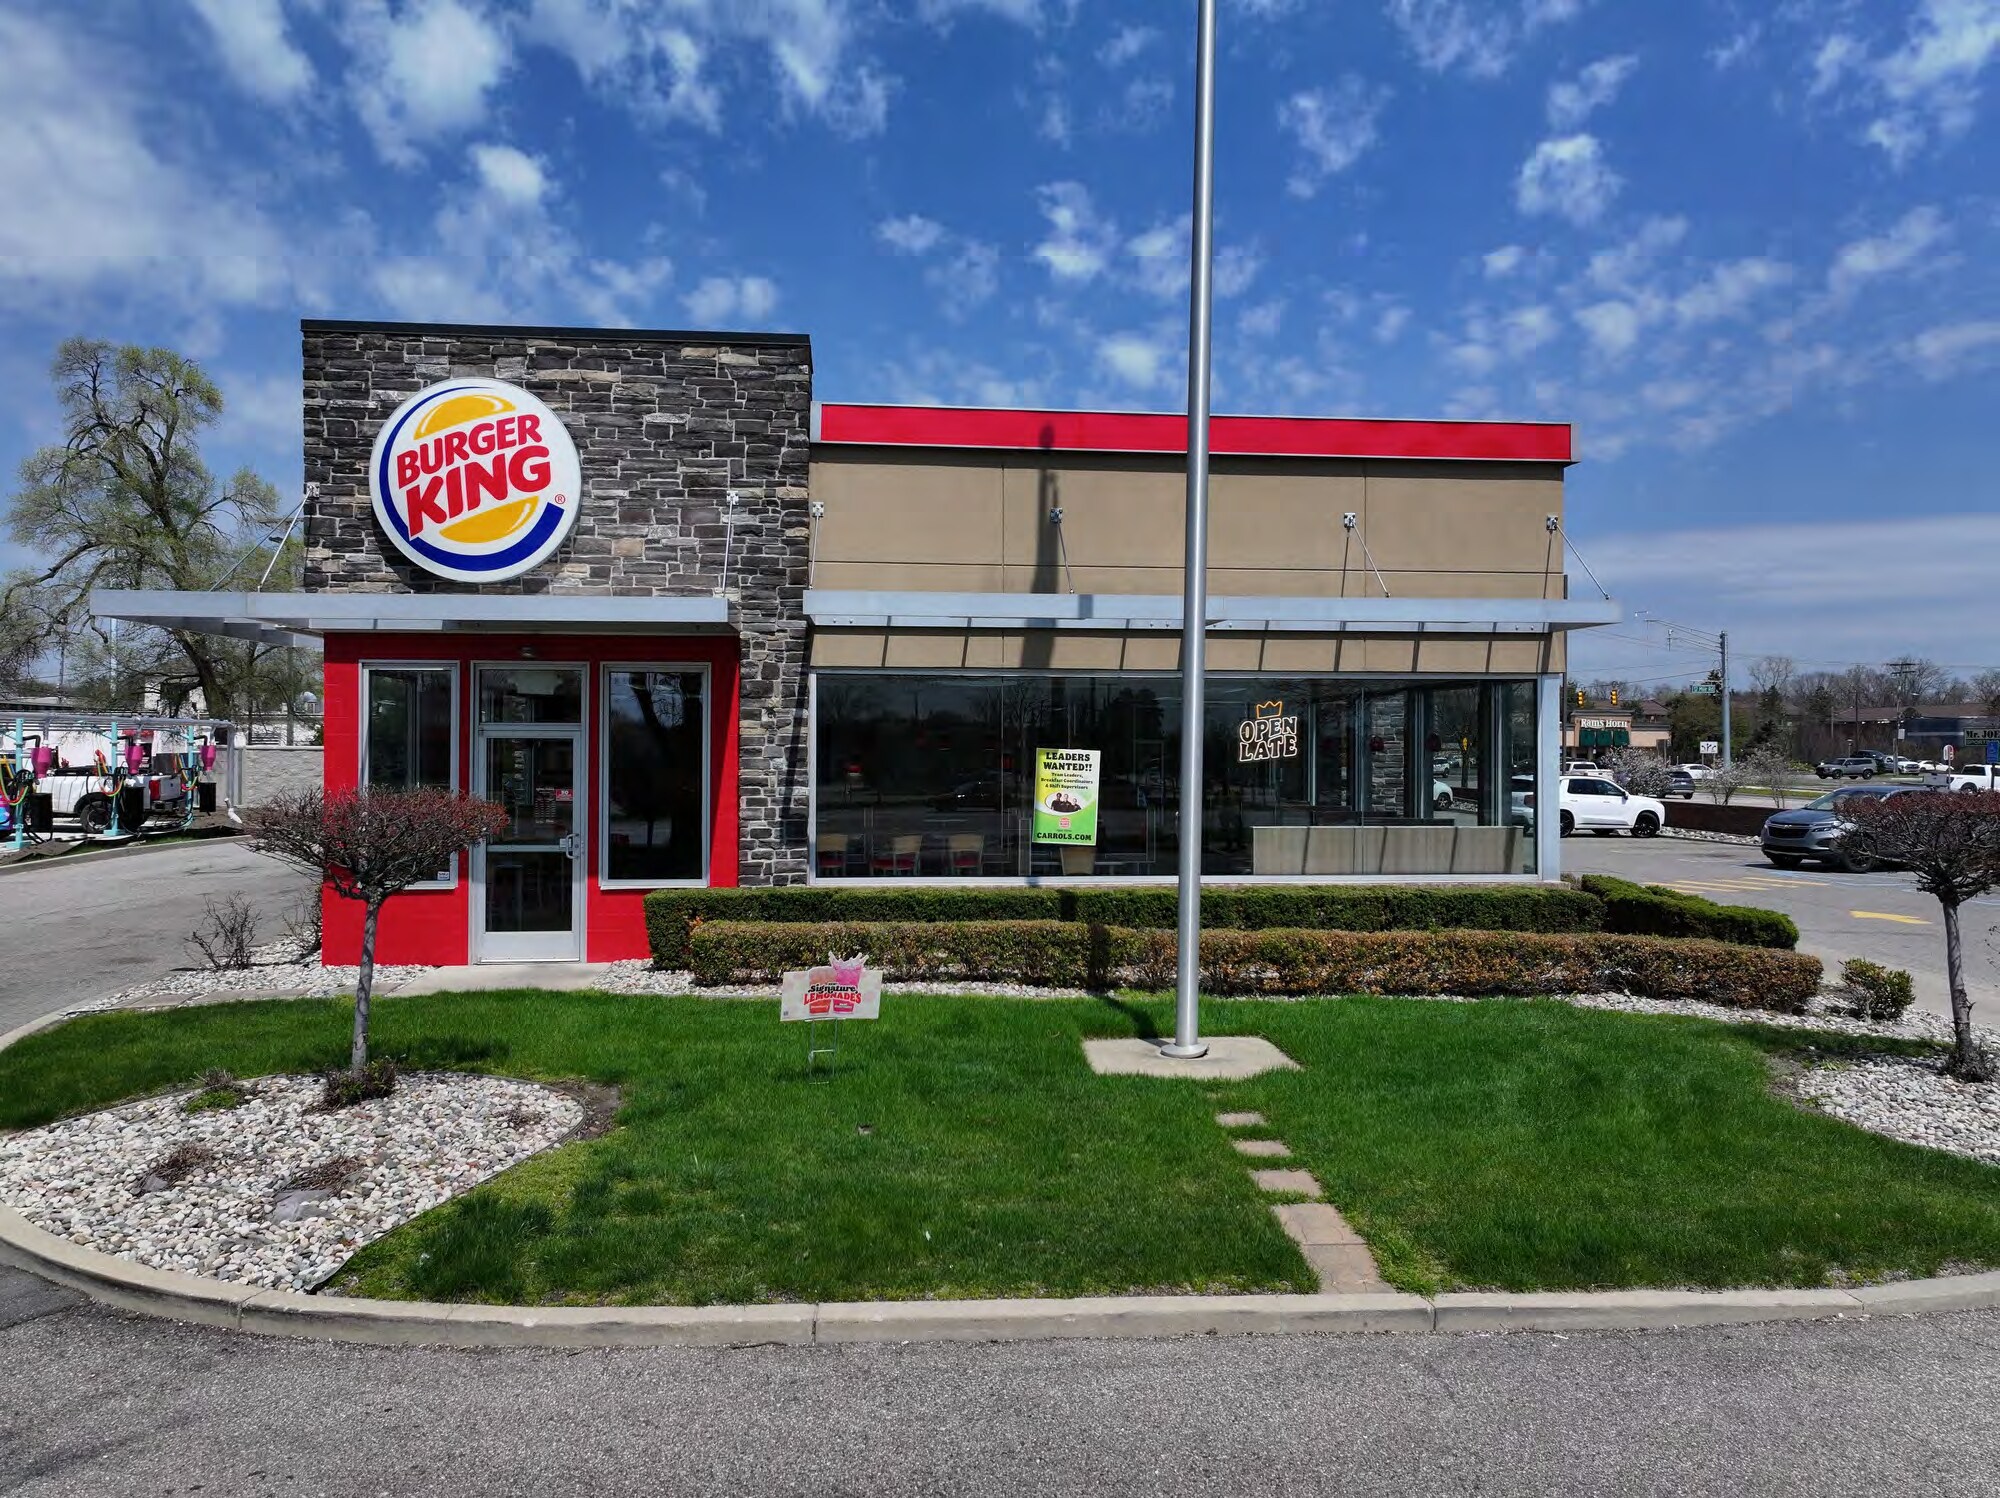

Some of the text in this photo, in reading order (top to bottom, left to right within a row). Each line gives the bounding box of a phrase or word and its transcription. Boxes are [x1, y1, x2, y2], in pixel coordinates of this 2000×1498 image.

[396, 414, 543, 490] BURGER
[406, 445, 551, 538] KING
[1239, 716, 1298, 744] OPEN
[1239, 734, 1298, 762] LATE
[1045, 752, 1091, 762] LEADERS
[1043, 762, 1093, 772] WANTED!!
[1036, 832, 1092, 841] CARROLS.COM
[808, 983, 859, 994] Signature
[803, 992, 862, 1005] LEMONADES
